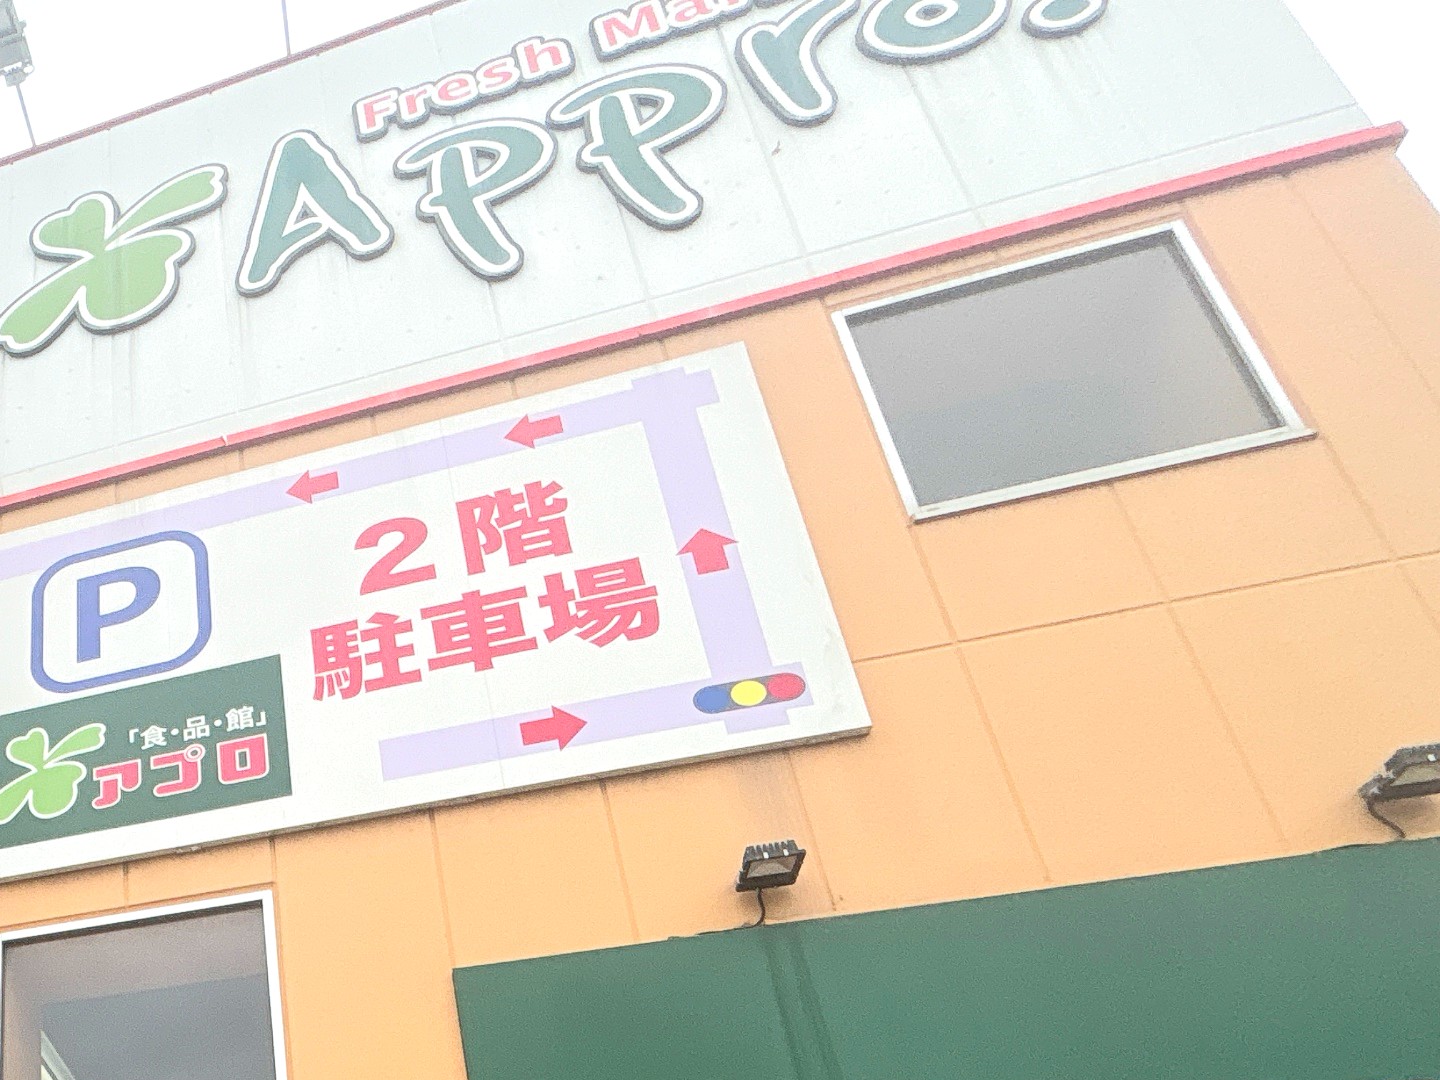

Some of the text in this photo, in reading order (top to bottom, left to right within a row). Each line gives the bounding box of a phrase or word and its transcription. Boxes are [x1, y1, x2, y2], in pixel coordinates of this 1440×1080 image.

[355, 37, 572, 139] Fresh
[354, 480, 574, 596] 2階
[76, 566, 161, 663] P
[310, 557, 659, 702] 駐車場
[91, 733, 269, 809] アプロ
